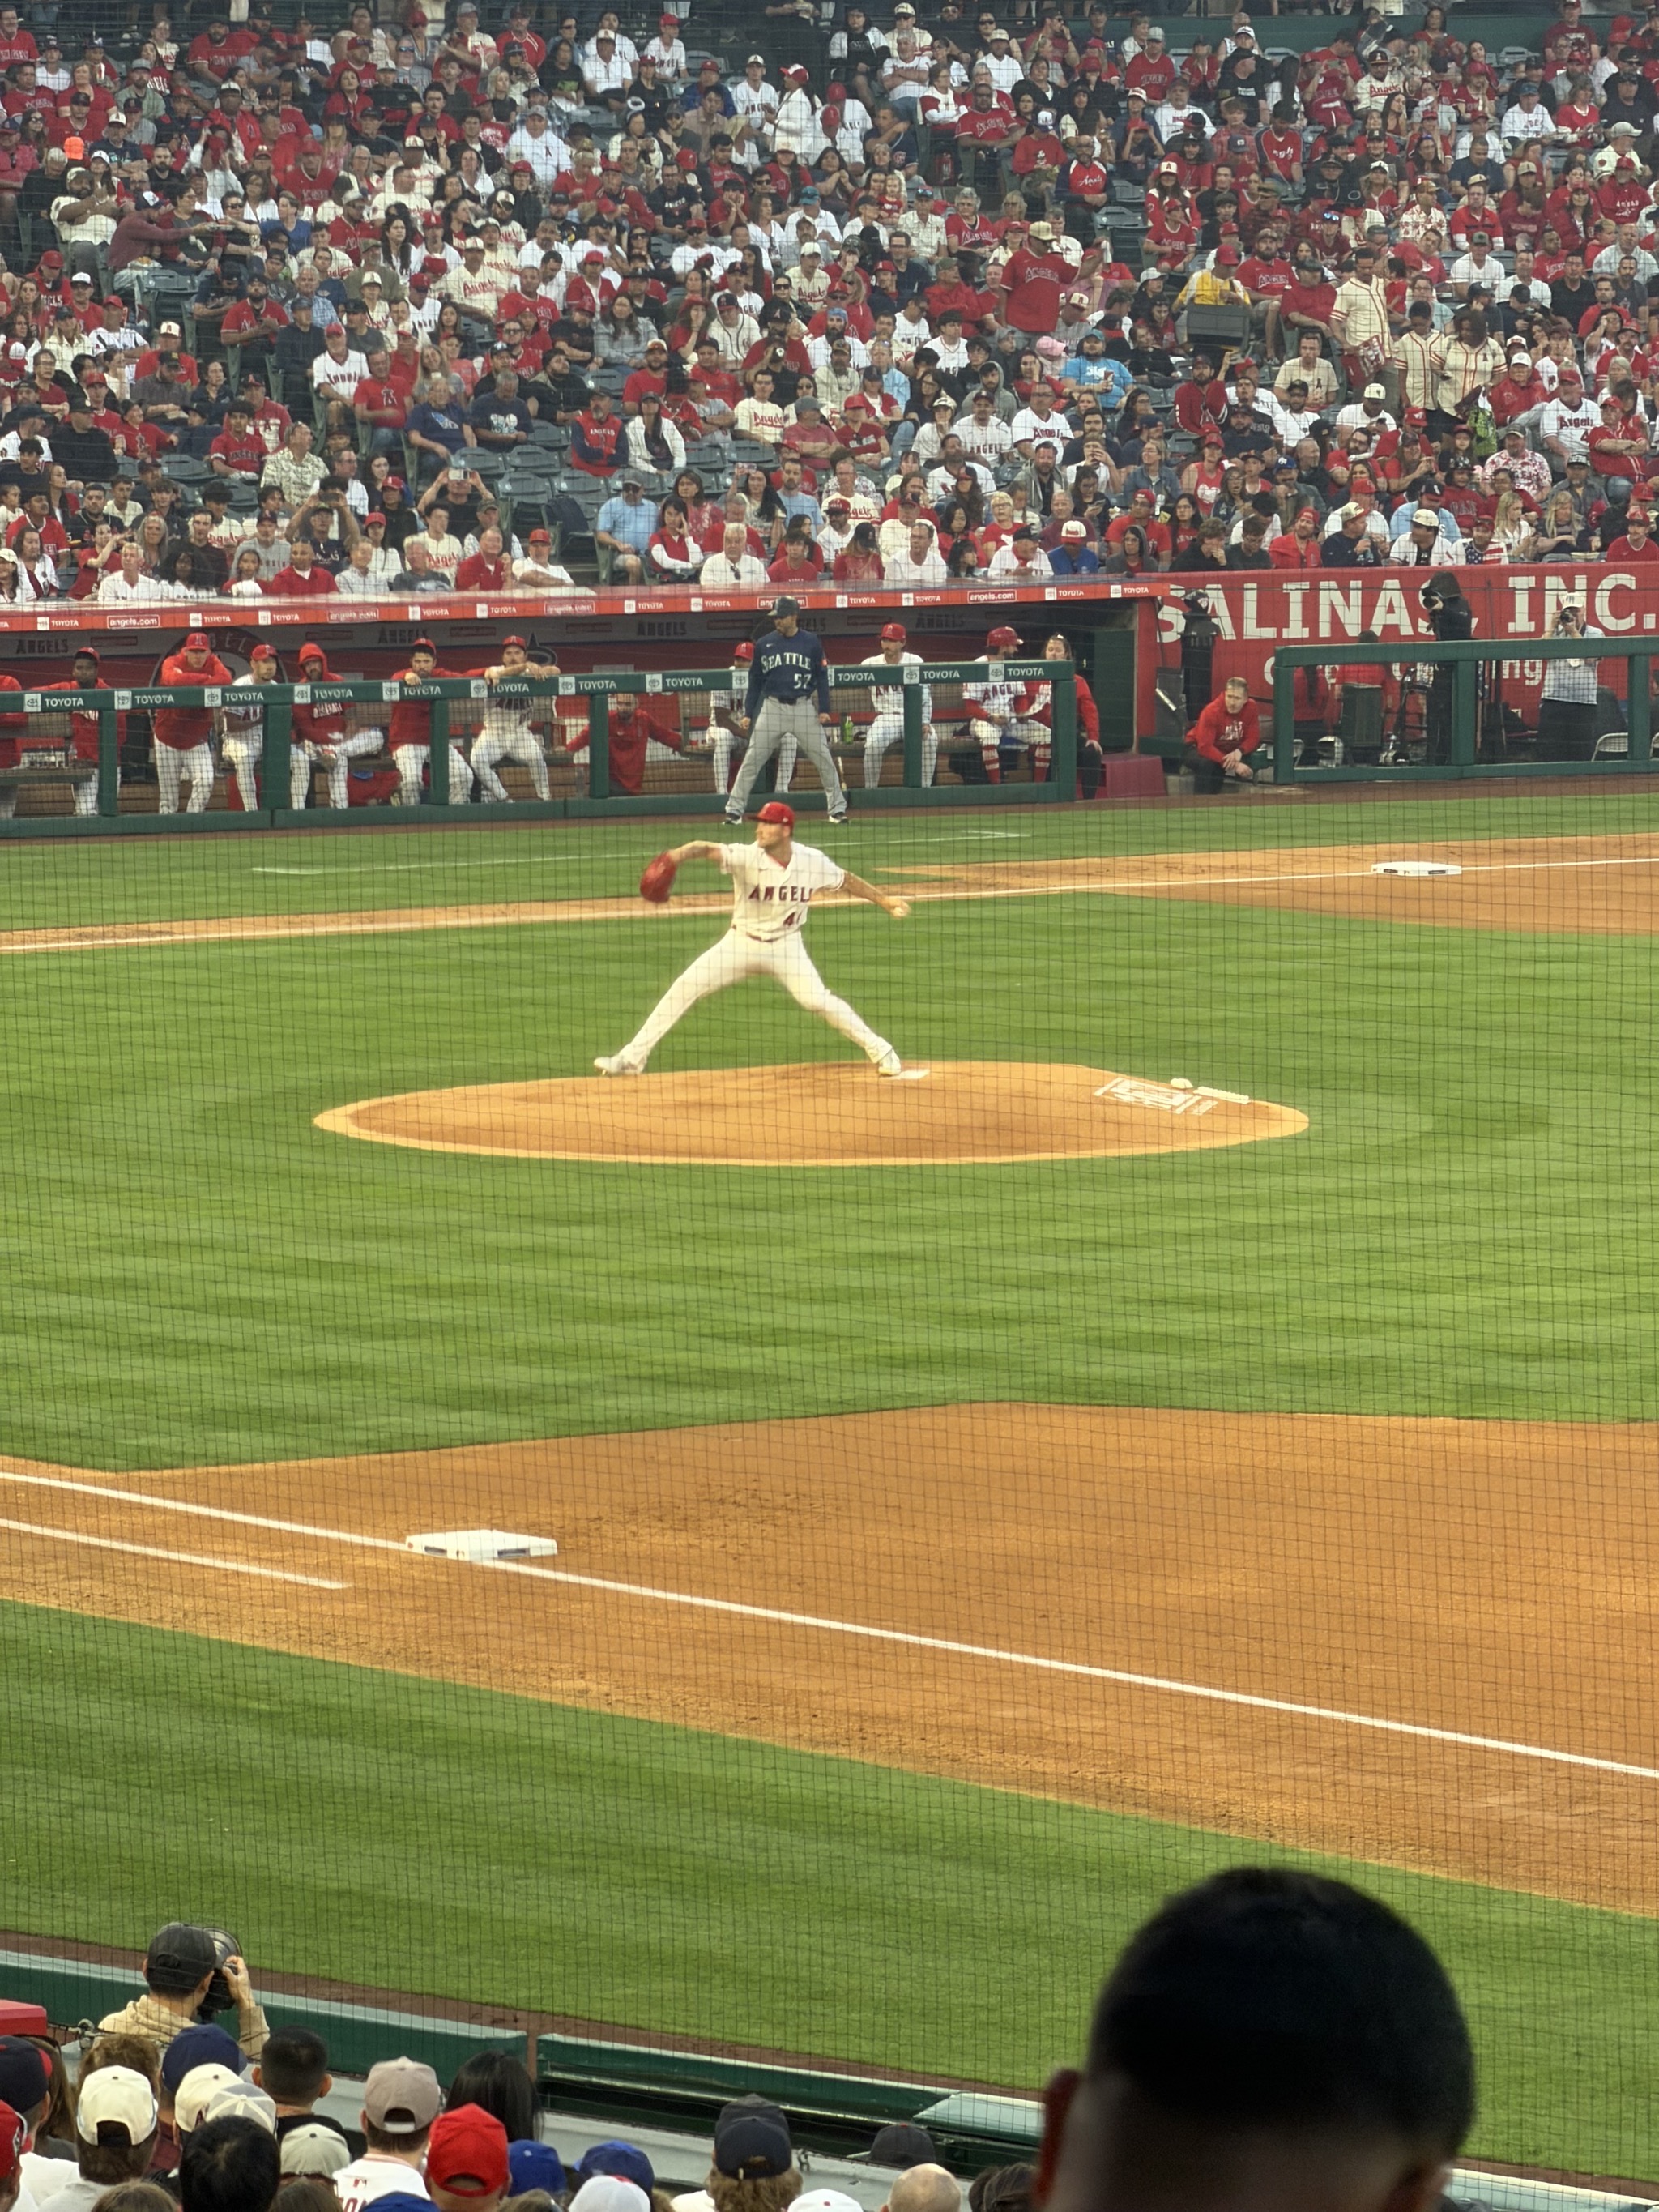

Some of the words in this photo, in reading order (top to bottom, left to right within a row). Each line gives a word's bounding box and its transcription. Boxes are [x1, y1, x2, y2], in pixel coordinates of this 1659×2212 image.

[970, 591, 1015, 601] angels.com
[1508, 573, 1656, 633] INC.
[51, 619, 79, 627] TOYOTA
[109, 617, 158, 627] angels.com
[761, 651, 811, 674] SEATTLE
[838, 672, 876, 681] TOYOTA
[923, 669, 960, 679] TOYOTA
[1007, 667, 1045, 677] TOYOTA
[578, 680, 616, 690] TOYOTA
[666, 677, 703, 687] TOYOTA
[794, 674, 812, 690] 57
[314, 689, 353, 698] TOYOTA
[403, 686, 441, 696] TOYOTA
[493, 683, 530, 694] TOYOTA
[135, 694, 174, 704] TOYOTA
[225, 692, 264, 702] TOYOTA
[45, 698, 84, 707] TOYOTA
